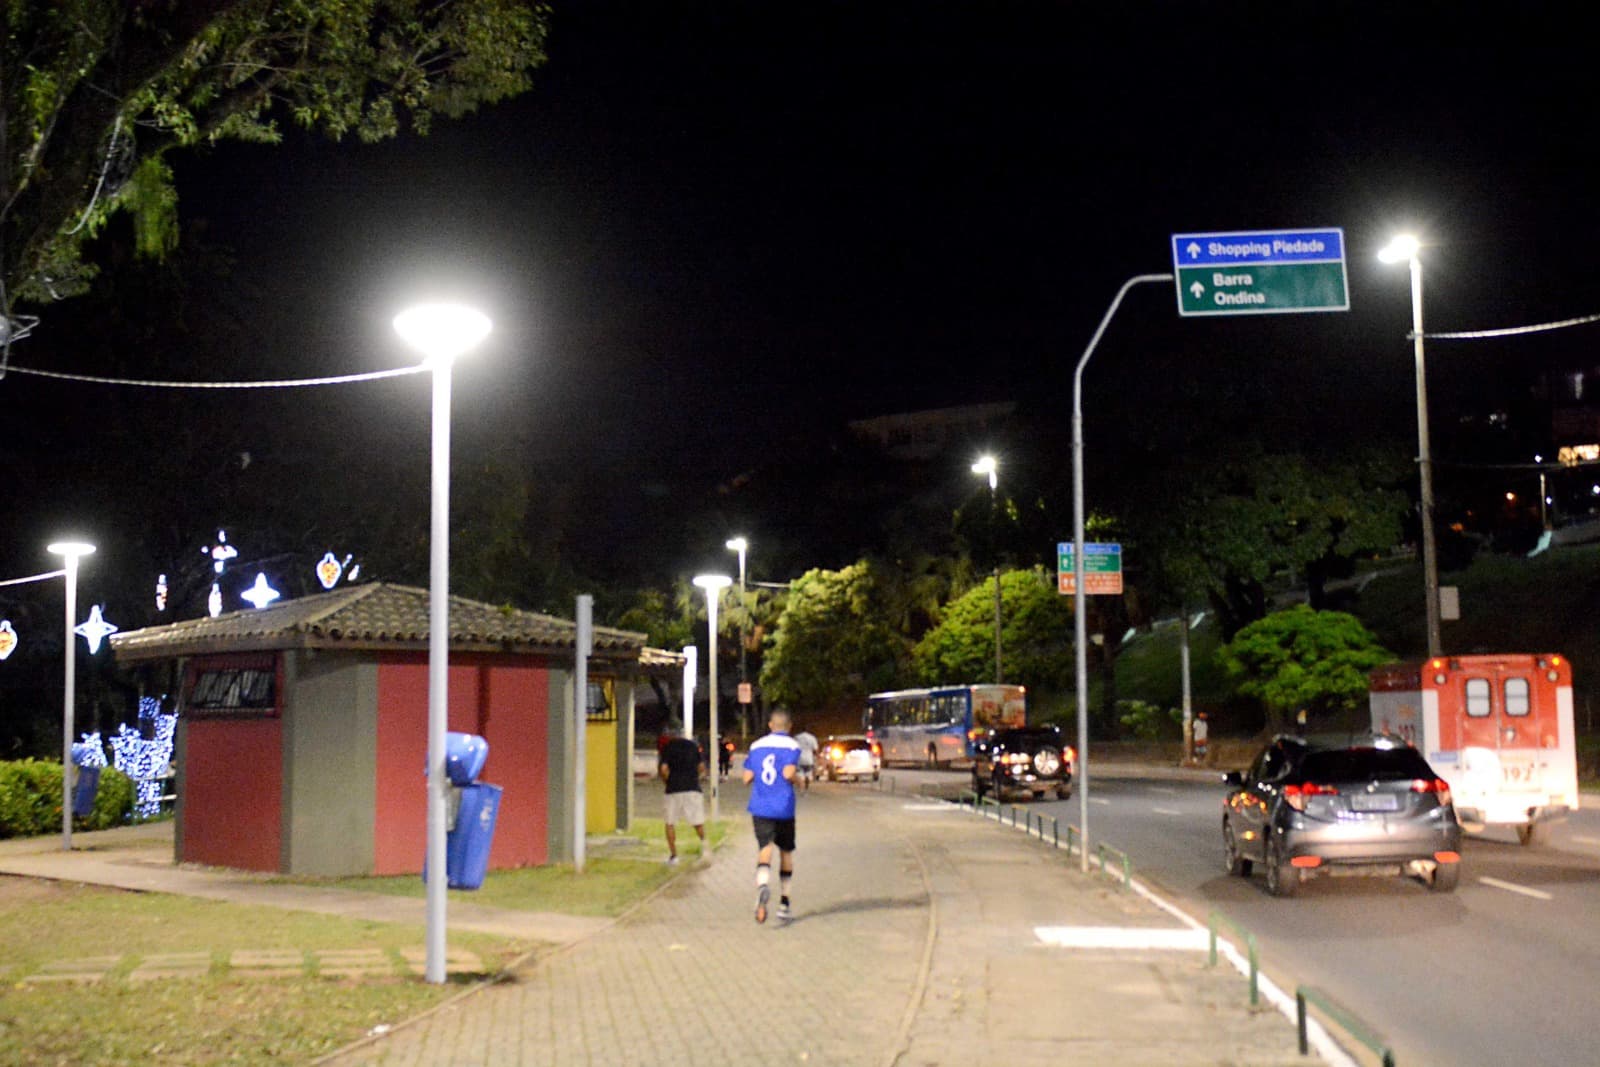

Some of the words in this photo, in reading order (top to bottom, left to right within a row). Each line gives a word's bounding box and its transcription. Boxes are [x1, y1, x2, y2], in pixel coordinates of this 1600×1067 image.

[1208, 242, 1270, 257] Shopping
[1272, 239, 1325, 254] Piedade
[1213, 272, 1253, 287] Barra
[1214, 291, 1265, 306] Ondina
